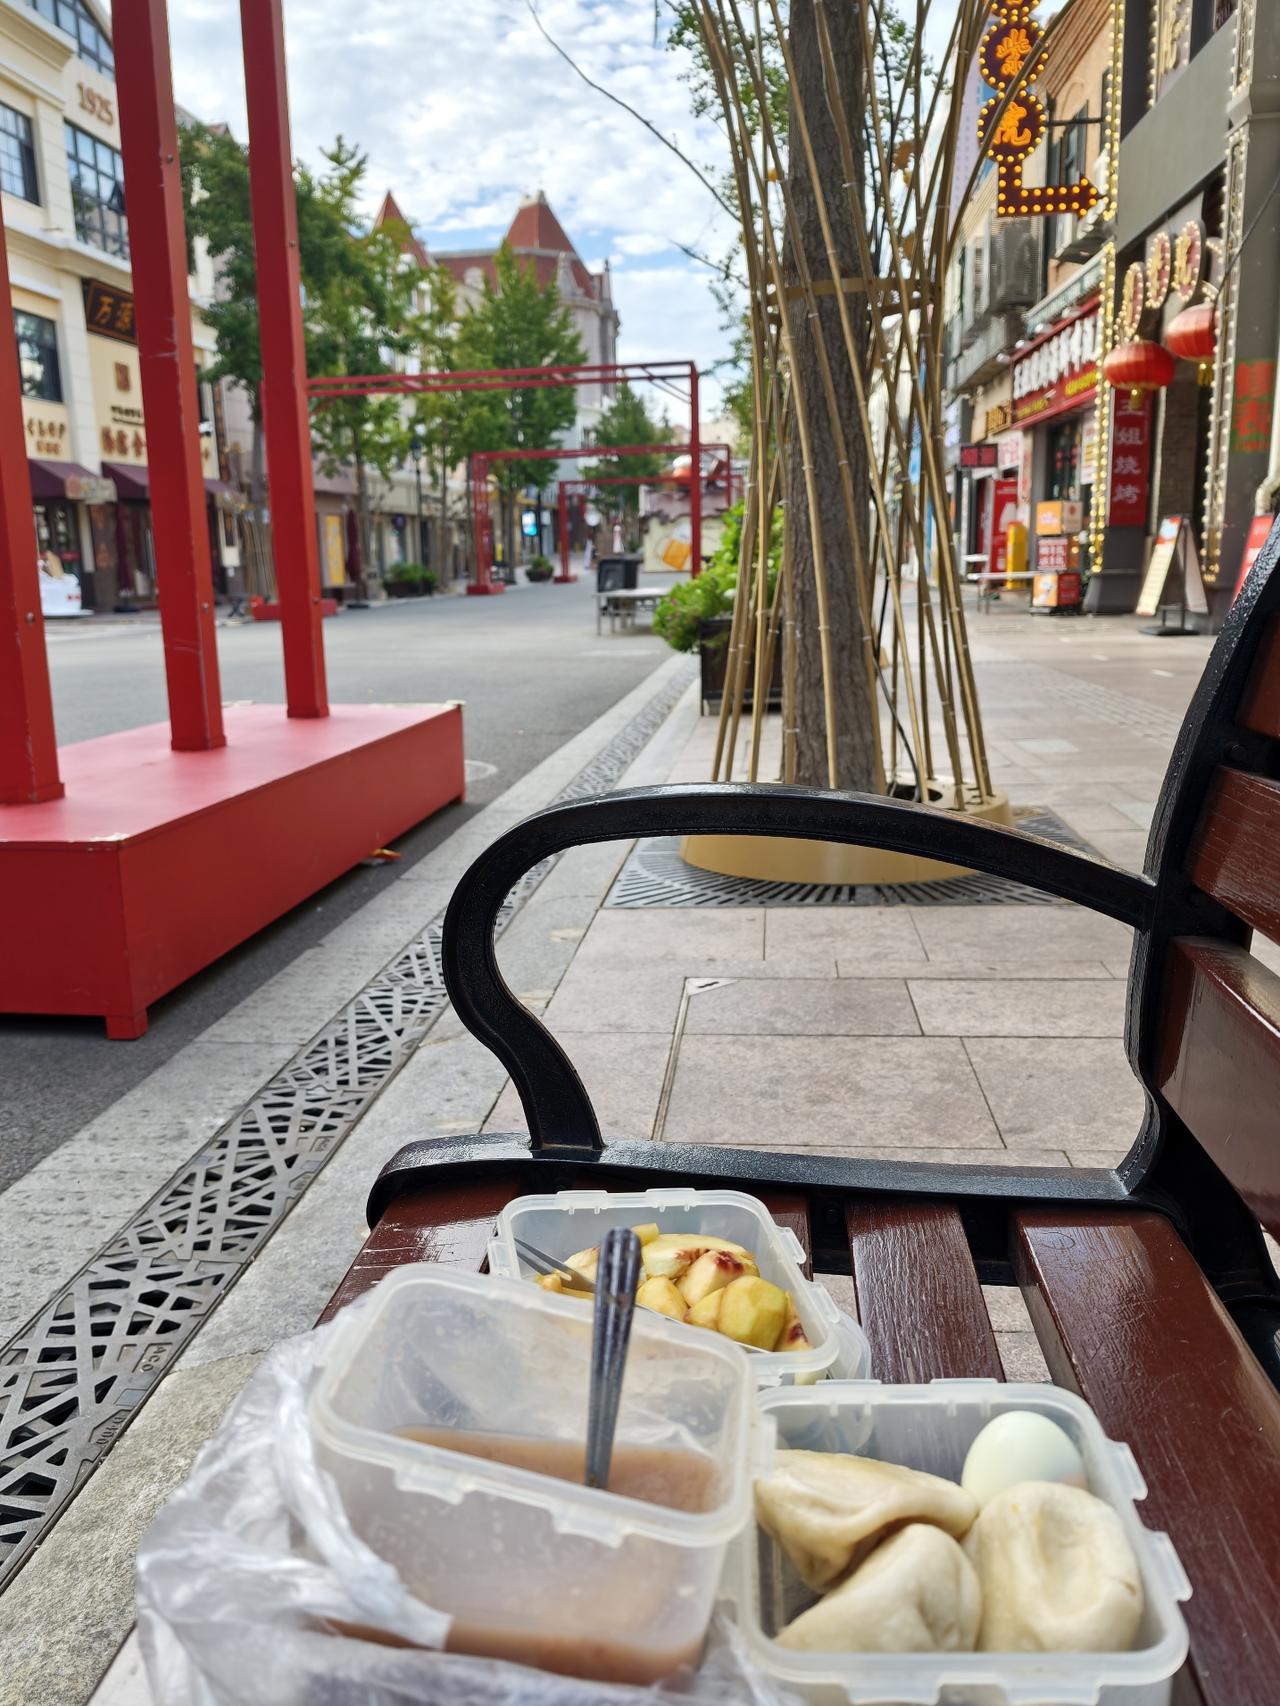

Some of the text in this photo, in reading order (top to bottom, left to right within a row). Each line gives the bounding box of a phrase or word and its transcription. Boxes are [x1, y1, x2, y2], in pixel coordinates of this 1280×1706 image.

[993, 0, 1033, 147] 柴院
[77, 81, 114, 127] 1925
[141, 1345, 167, 1373] ACO
